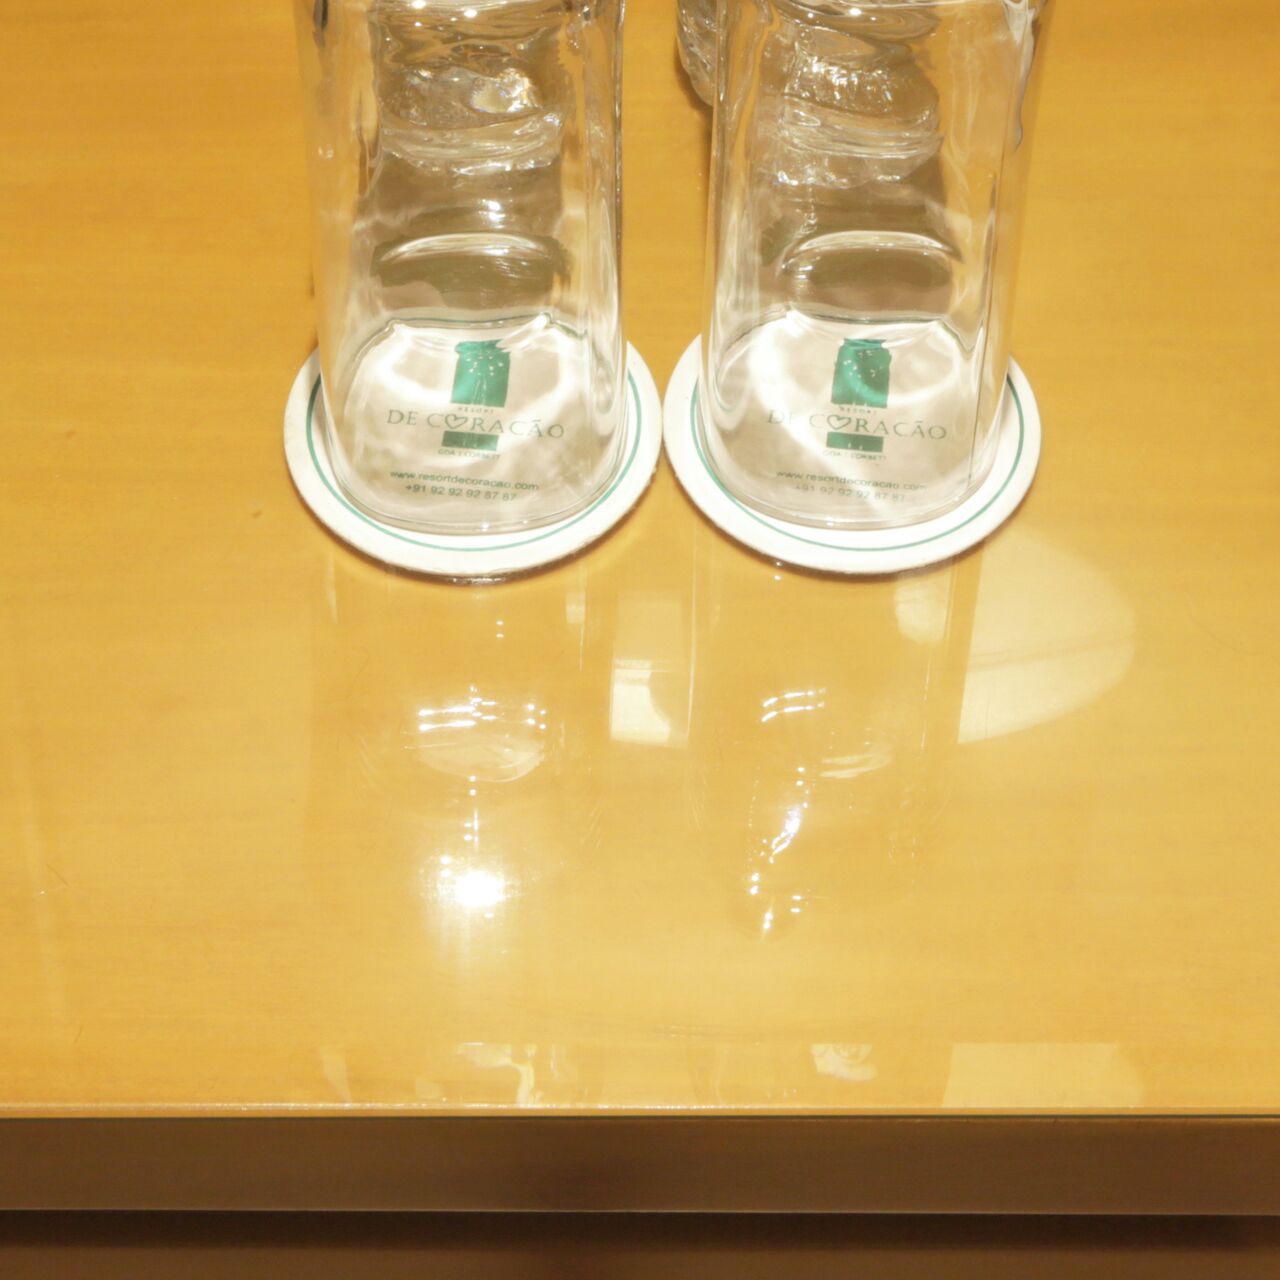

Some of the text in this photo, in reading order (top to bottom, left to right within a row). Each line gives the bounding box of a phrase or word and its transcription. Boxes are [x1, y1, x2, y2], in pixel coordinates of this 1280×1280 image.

[387, 409, 417, 425] DE
[390, 471, 540, 491] www.resortdecoracao.com
[406, 484, 517, 501] +91 92 92 92 87 87
